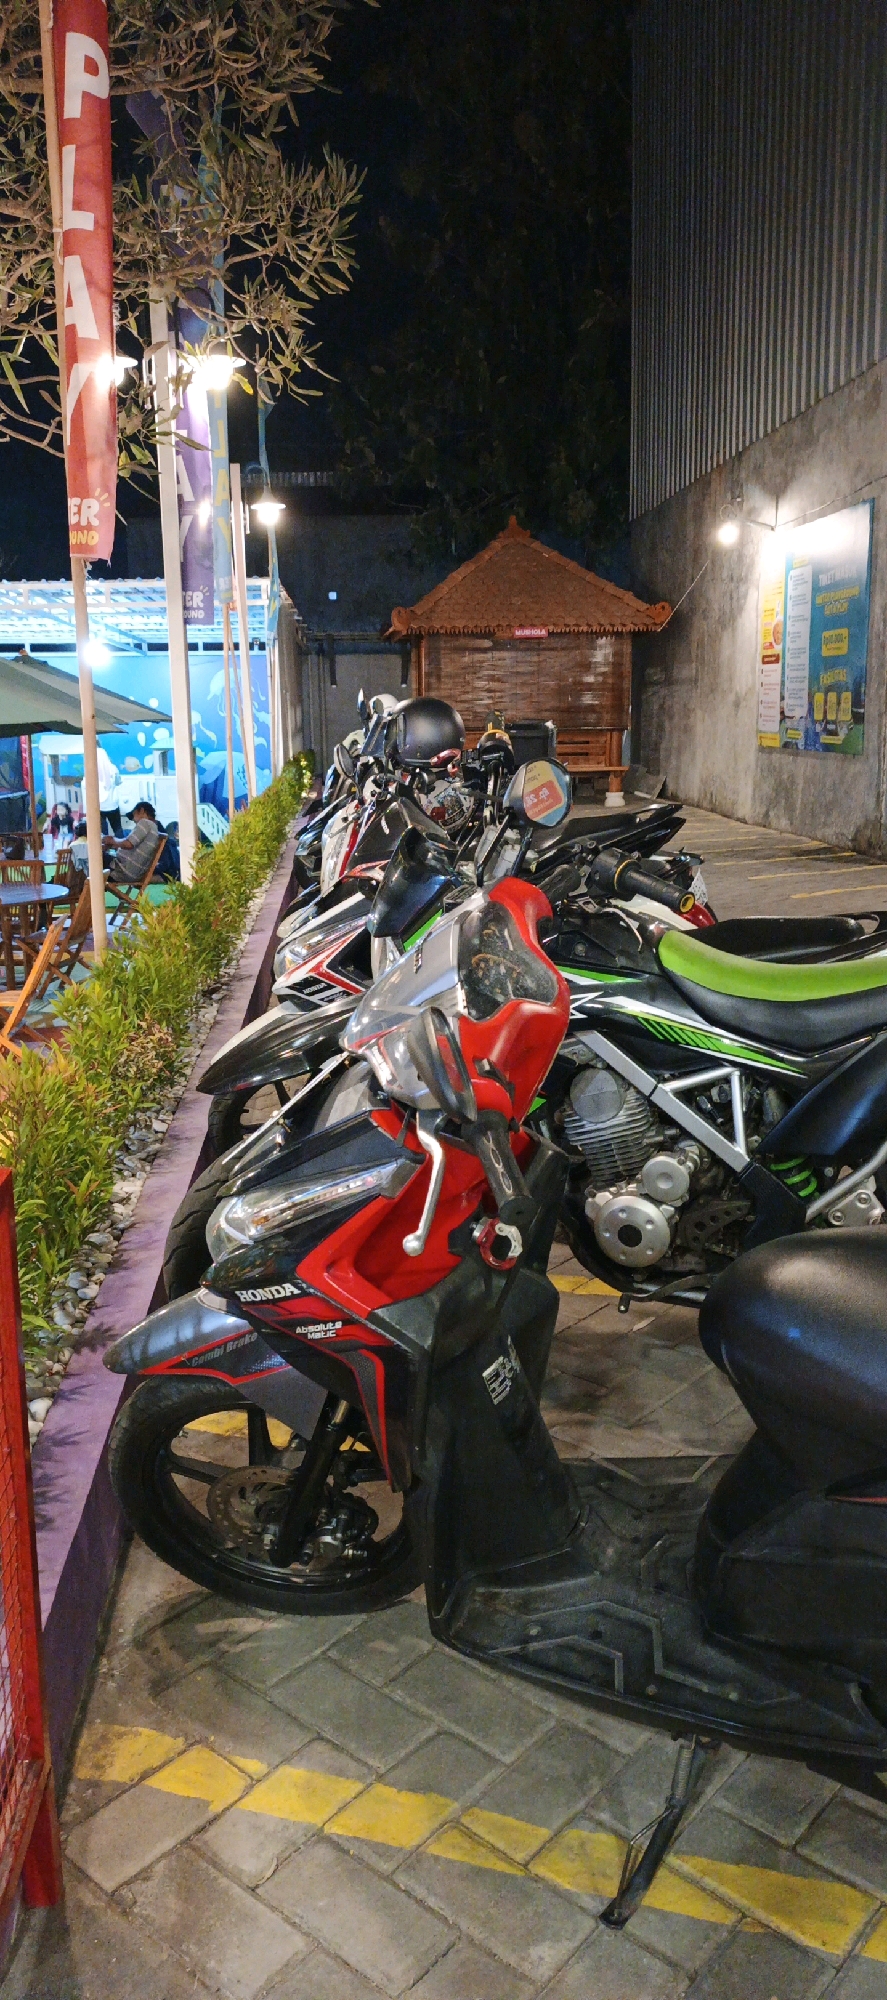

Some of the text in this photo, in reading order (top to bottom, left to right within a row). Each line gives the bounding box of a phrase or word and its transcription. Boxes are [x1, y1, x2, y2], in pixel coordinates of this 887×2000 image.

[302, 982, 329, 994] HONDA
[235, 1282, 301, 1305] HONDA
[295, 1320, 342, 1335] Absolute
[307, 1329, 337, 1340] Matic
[191, 1332, 259, 1367] Combi Brake
